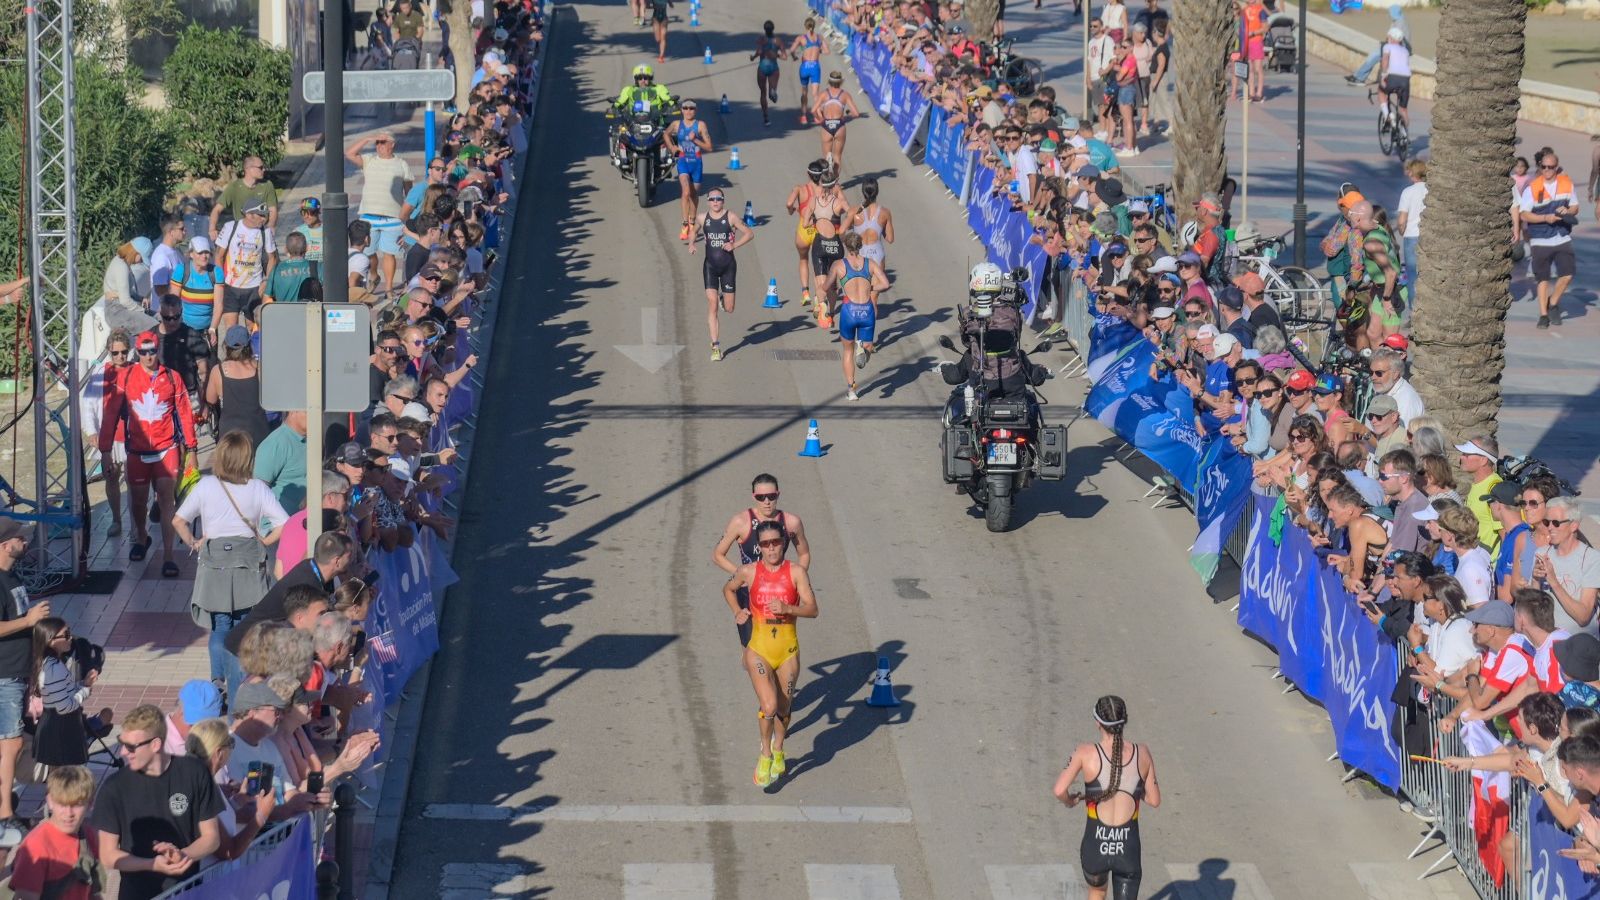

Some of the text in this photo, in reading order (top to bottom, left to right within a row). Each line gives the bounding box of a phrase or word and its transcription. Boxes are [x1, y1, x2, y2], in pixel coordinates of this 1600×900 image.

[707, 232, 727, 240] HOLLAND
[710, 240, 724, 248] GBR
[1095, 825, 1131, 841] KLAMT
[1099, 841, 1125, 855] GER
